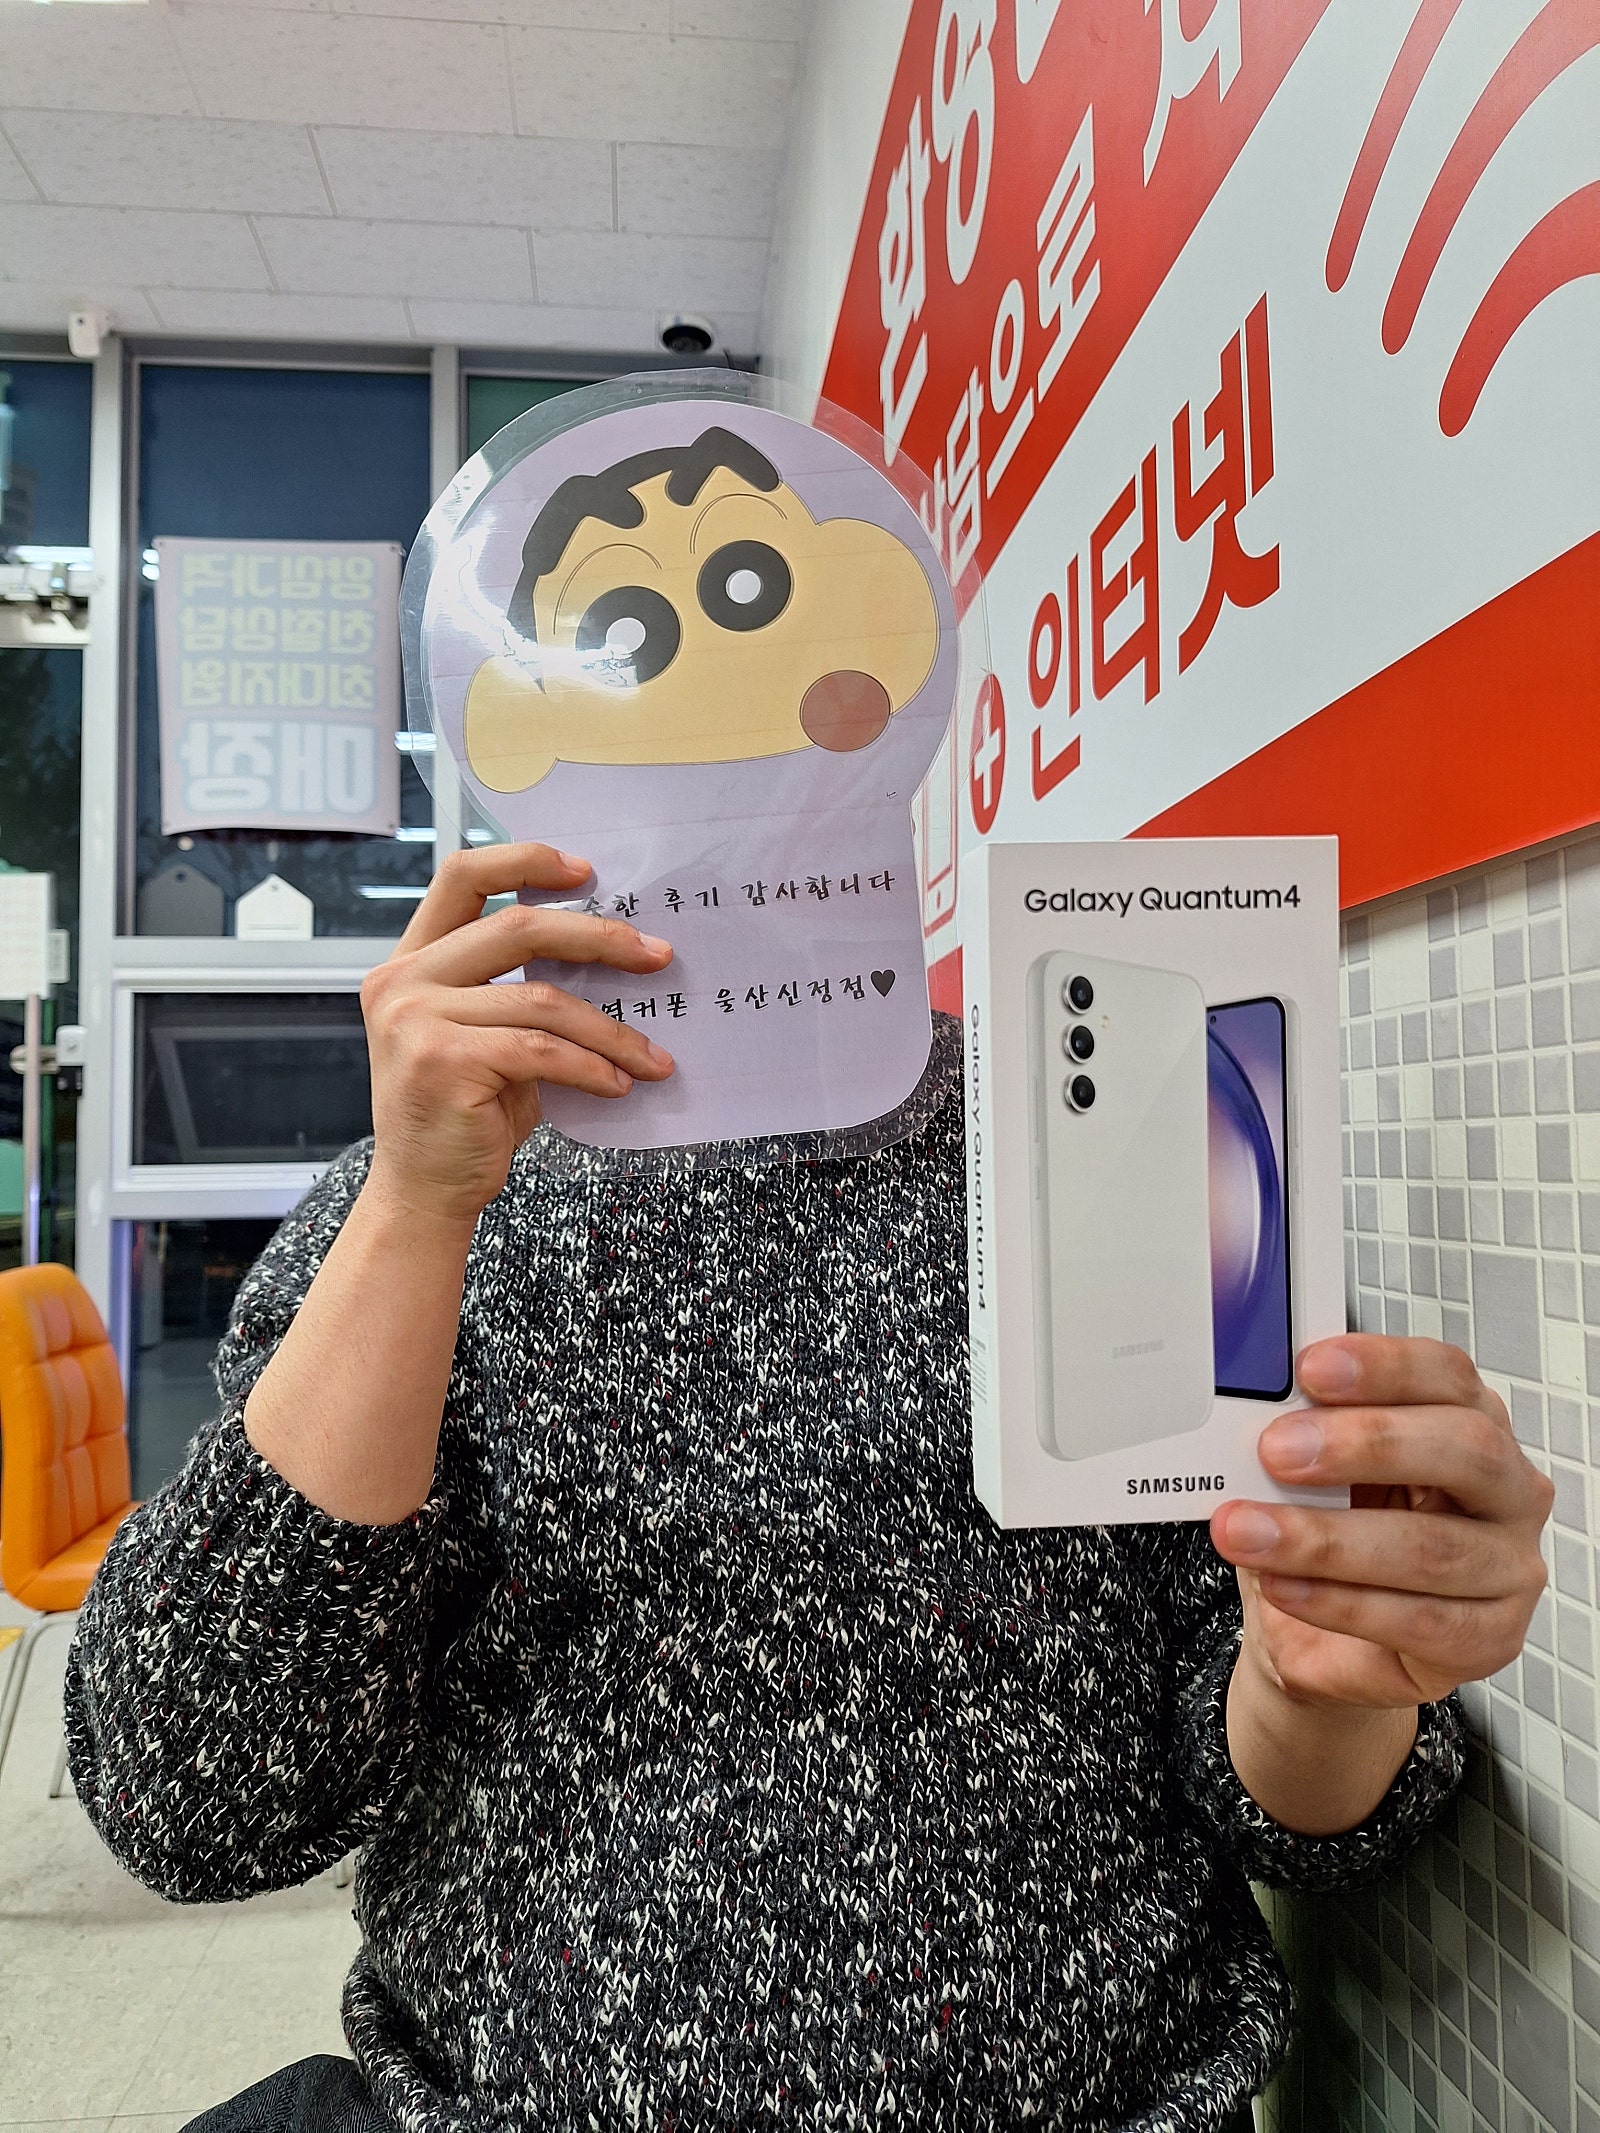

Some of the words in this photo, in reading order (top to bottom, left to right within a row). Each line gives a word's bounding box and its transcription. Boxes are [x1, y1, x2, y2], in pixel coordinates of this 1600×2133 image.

[1027, 290, 1281, 802] 인터넷
[664, 887, 720, 913] 후기
[741, 870, 897, 907] 감사합니다
[1023, 888, 1135, 918] Galaxy
[1138, 884, 1301, 911] Quantum4
[714, 975, 866, 1013] 울산신정점
[970, 1004, 982, 1125] Galaxy
[973, 1131, 987, 1311] Quantum4
[1126, 1475, 1225, 1495] SAMSUNG
